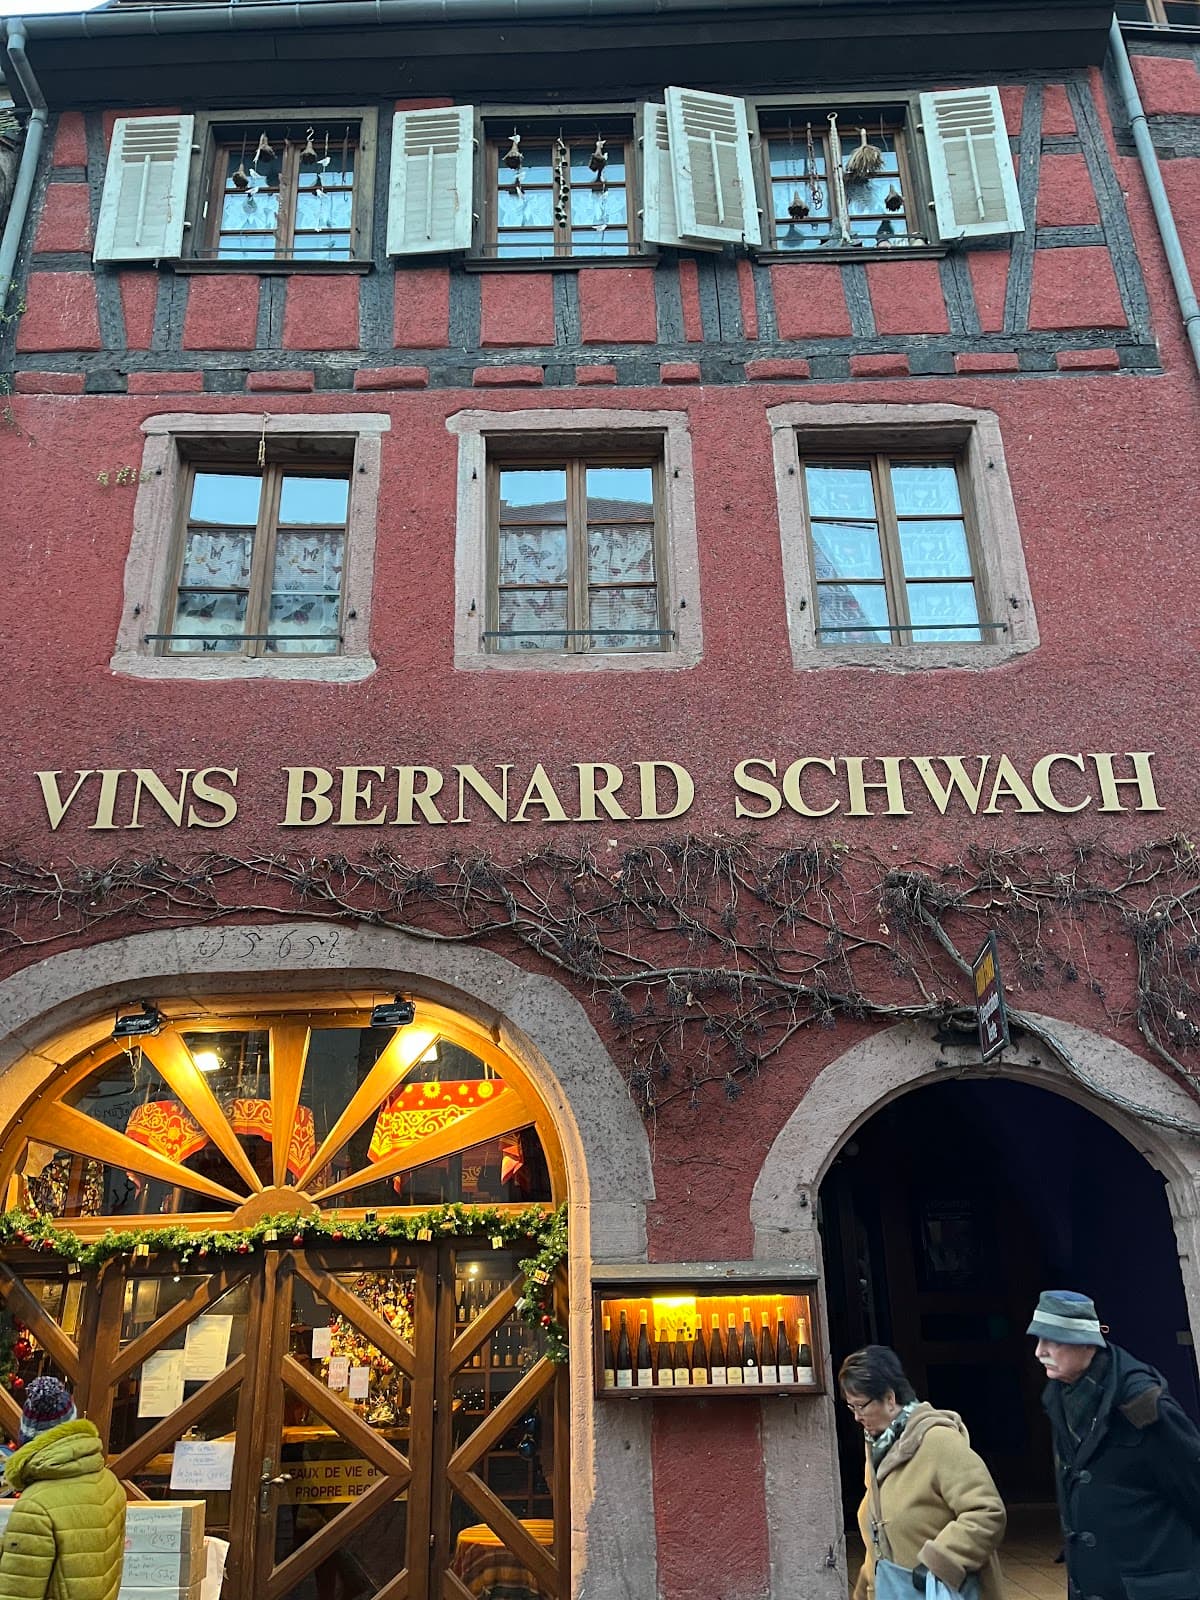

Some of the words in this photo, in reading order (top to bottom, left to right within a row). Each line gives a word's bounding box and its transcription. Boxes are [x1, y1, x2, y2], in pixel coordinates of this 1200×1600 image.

[35, 766, 240, 831] VINS
[277, 758, 697, 828] BERNARD
[733, 751, 1163, 819] SCHWACH
[324, 1466, 341, 1478] DE
[345, 1465, 363, 1477] VIE
[367, 1464, 378, 1477] et
[295, 1485, 342, 1498] PROPRE
